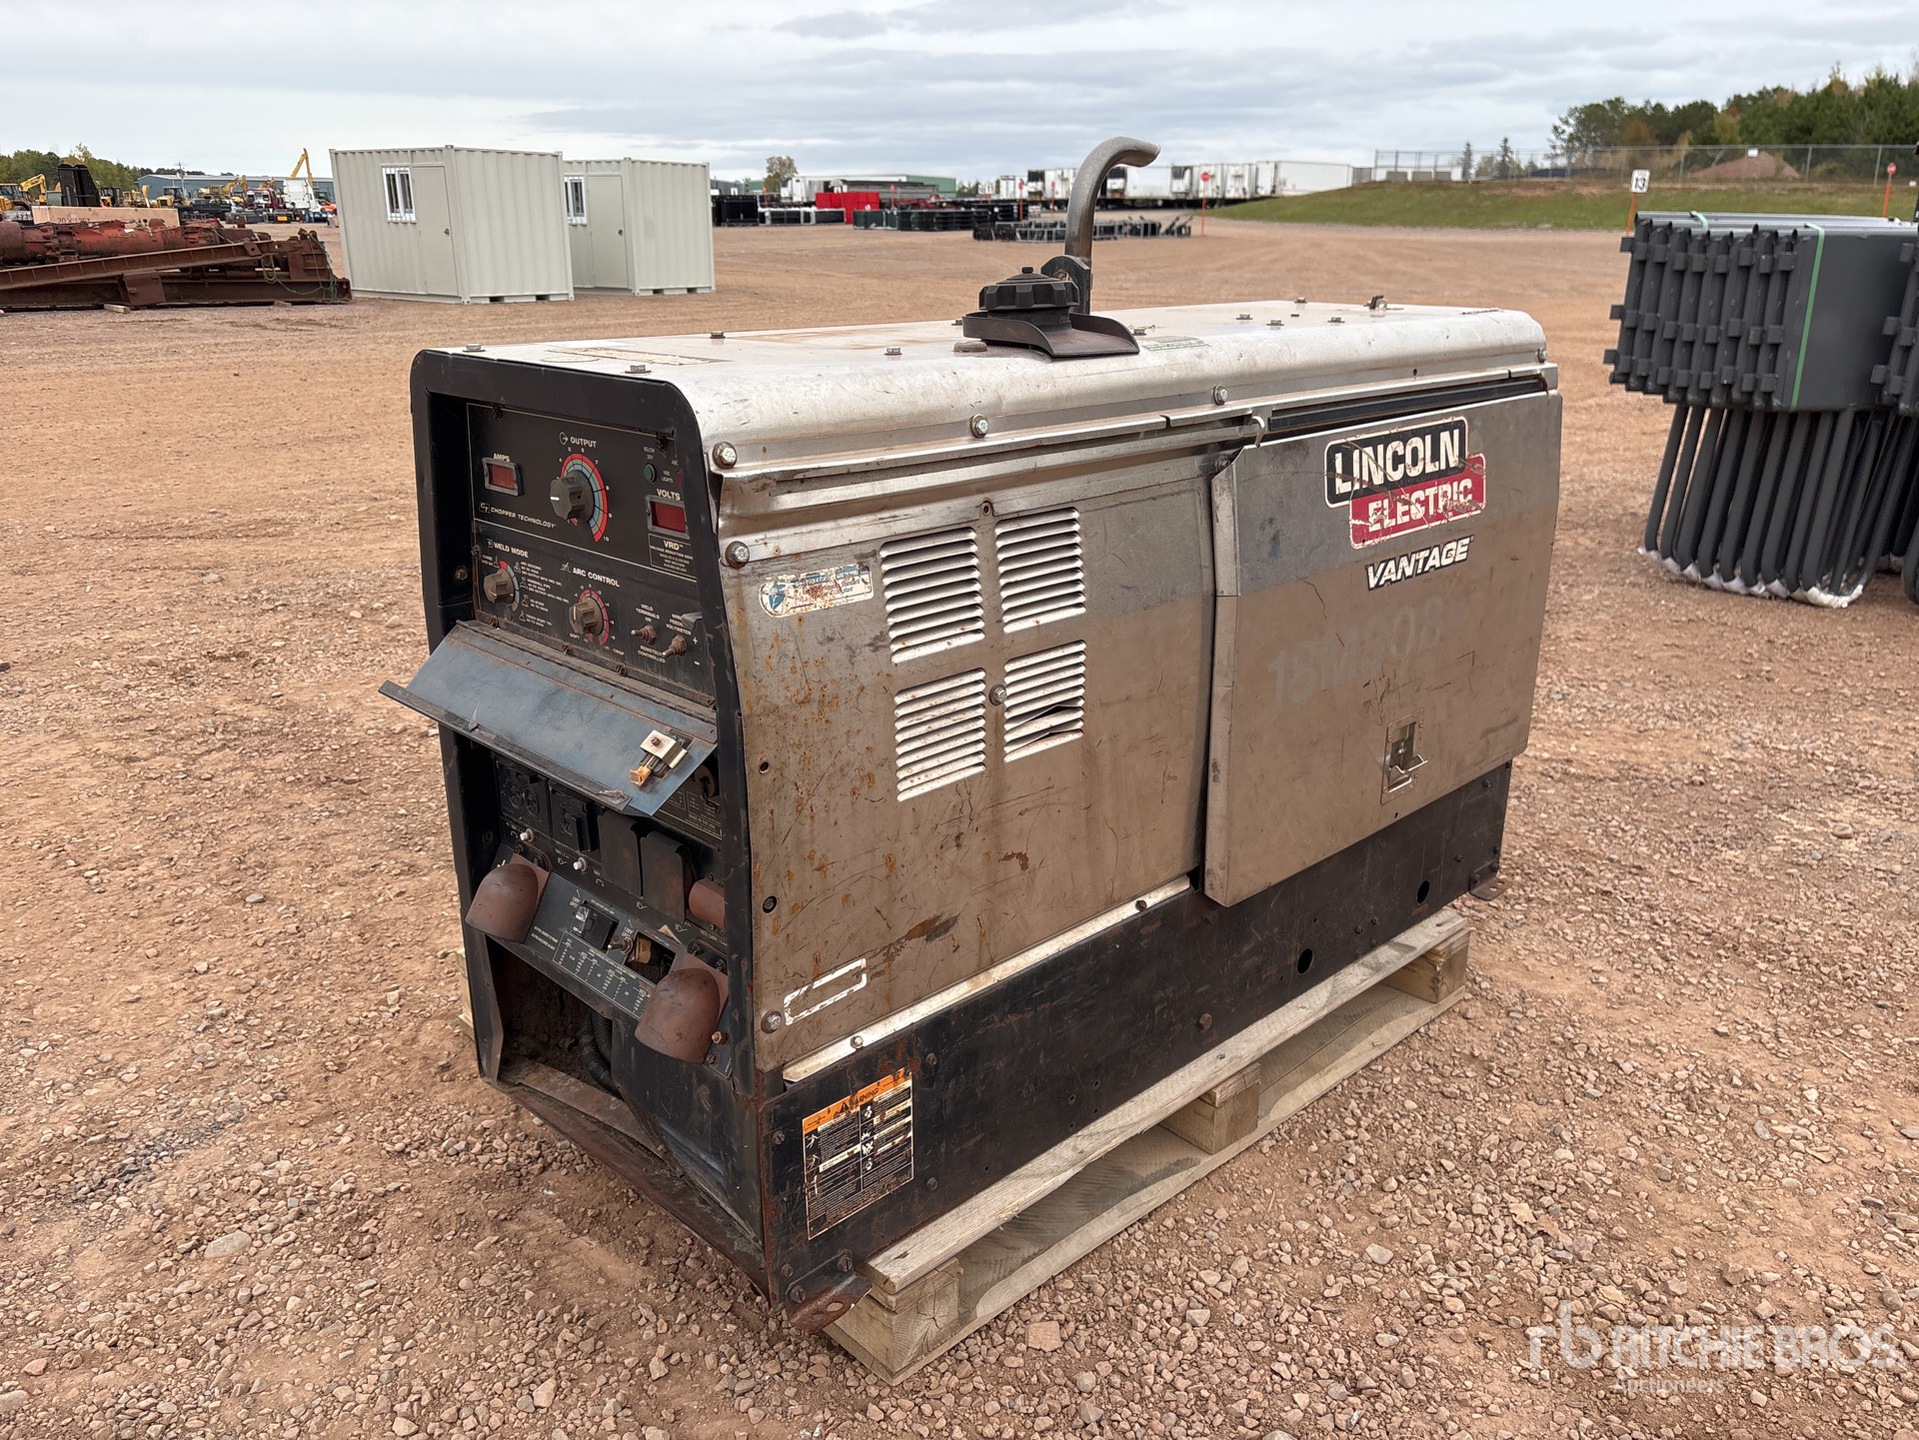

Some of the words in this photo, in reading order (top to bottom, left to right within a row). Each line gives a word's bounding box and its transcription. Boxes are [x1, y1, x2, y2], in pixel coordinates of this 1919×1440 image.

[570, 437, 597, 448] OUTPUT
[493, 452, 511, 462] AMPS
[1334, 428, 1460, 495] LINCOLN
[656, 488, 681, 501] VOLTS
[491, 507, 516, 520] CHOPPER
[1368, 478, 1473, 533] ELECTRIC
[493, 541, 510, 552] WELD
[510, 547, 529, 558] MODE
[1368, 537, 1471, 590] VANTAGE
[573, 567, 586, 577] ARC
[588, 571, 620, 587] CONTROL
